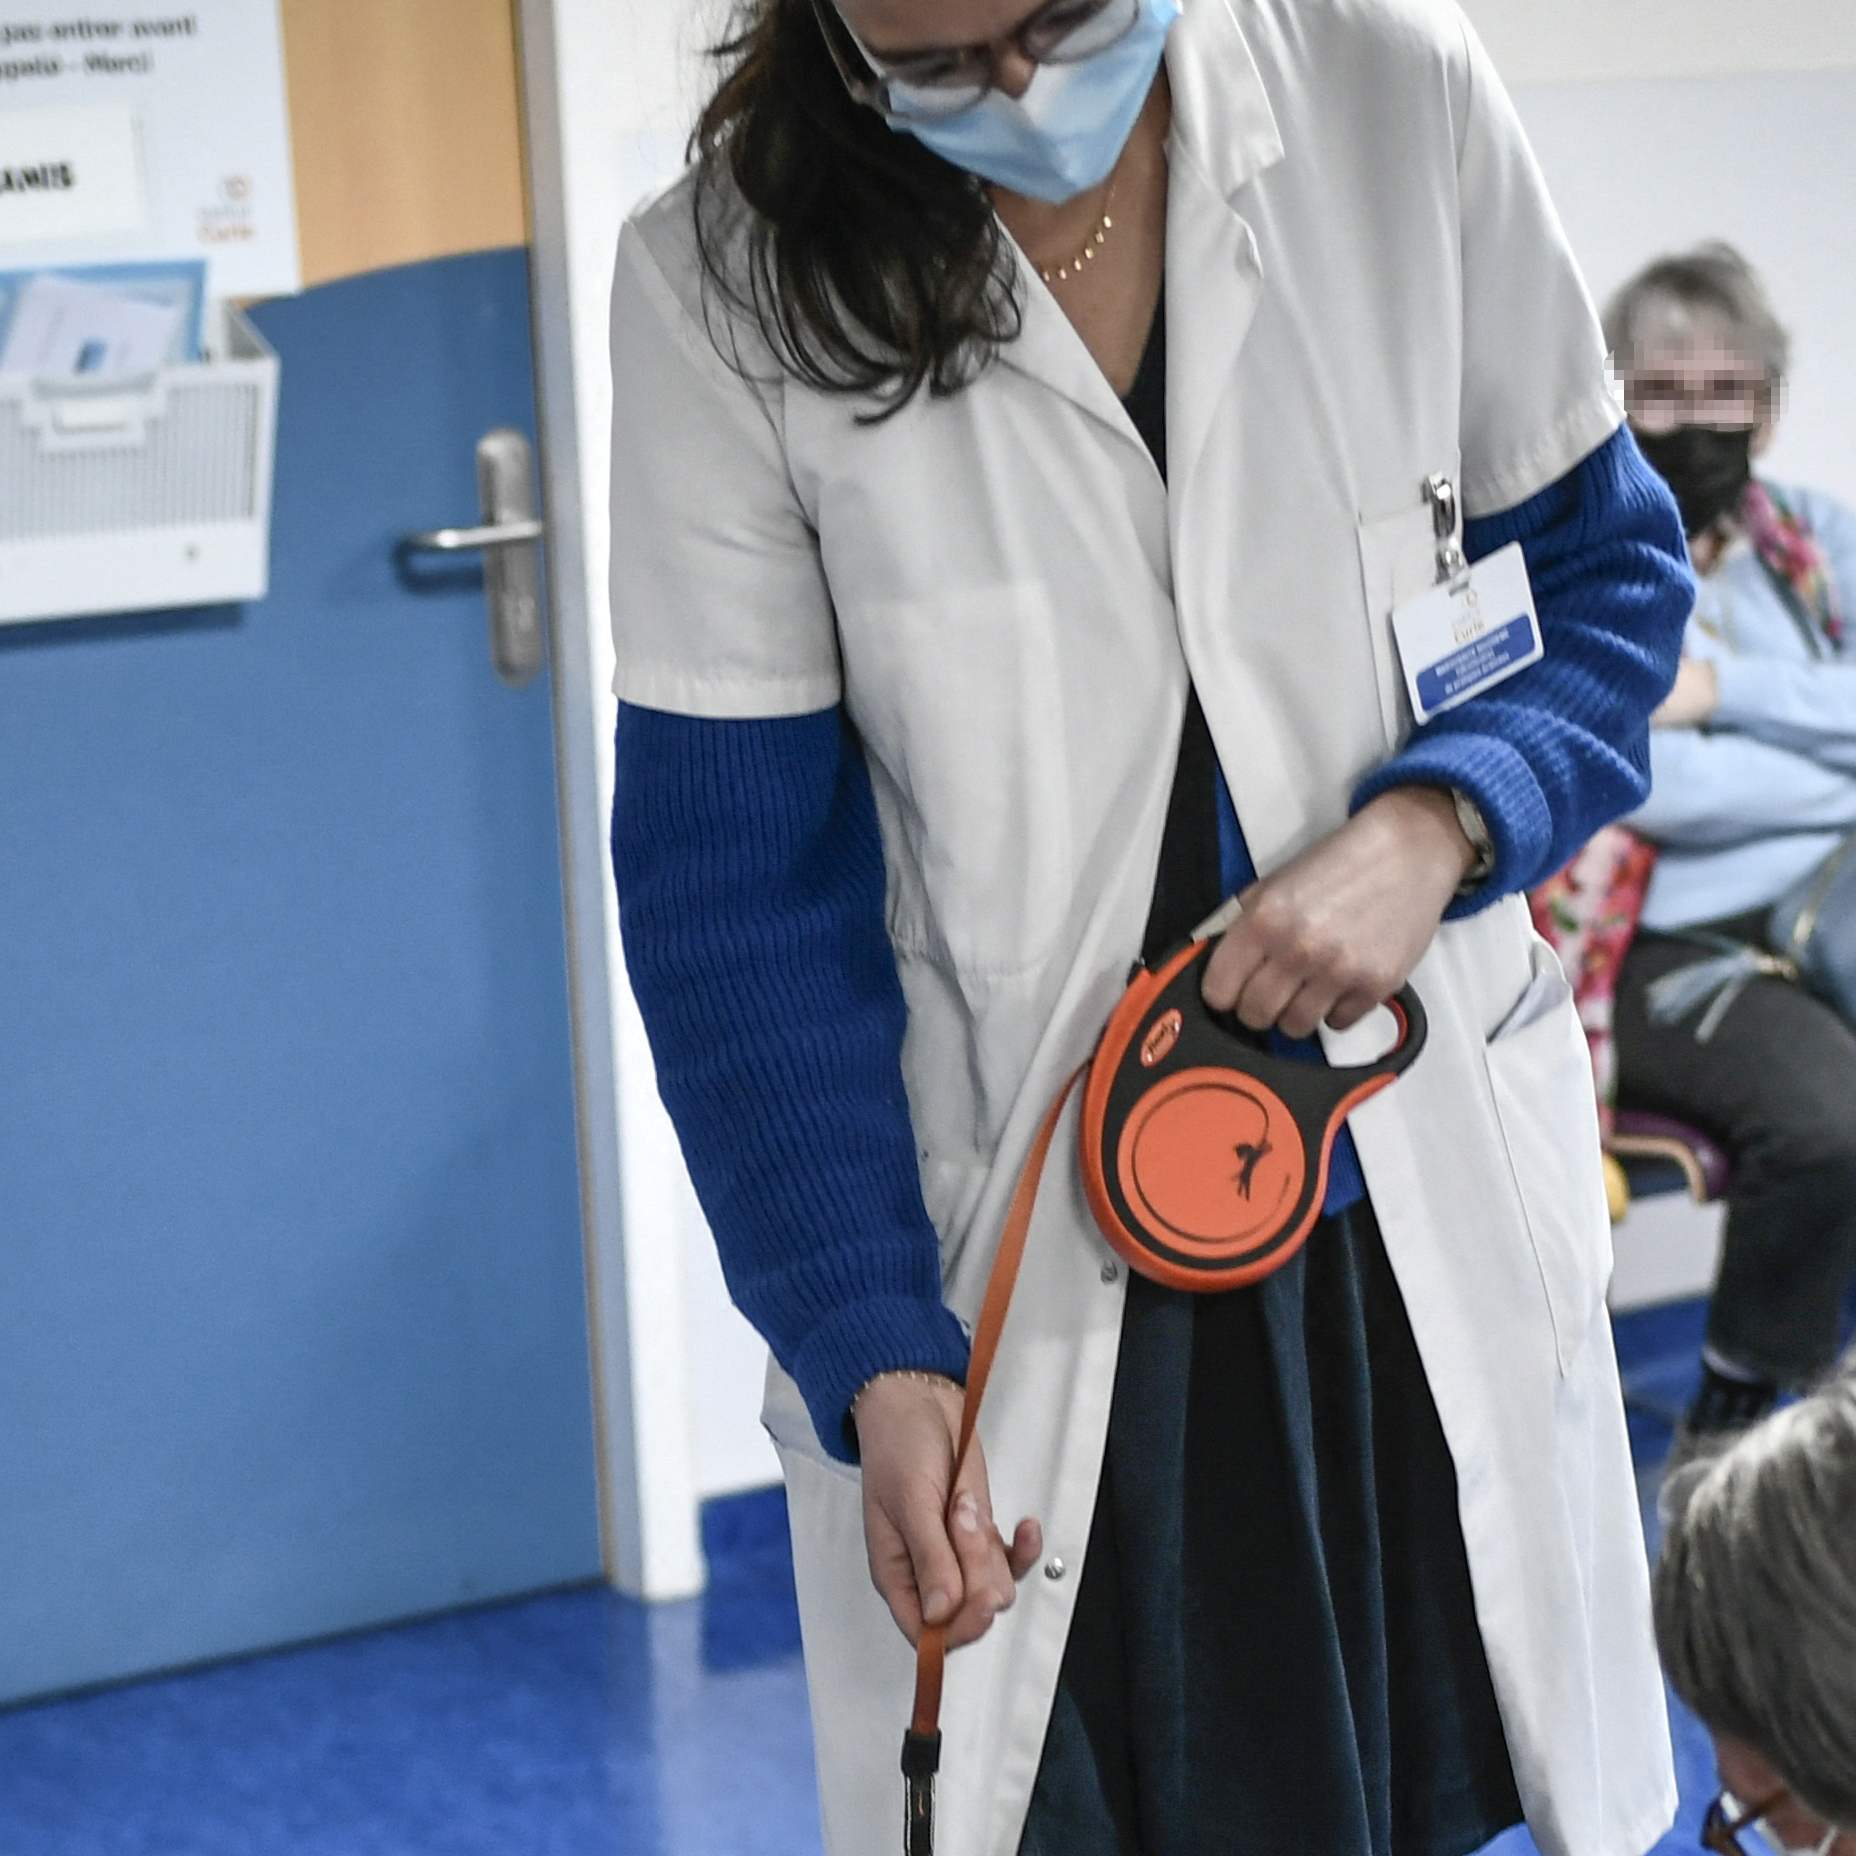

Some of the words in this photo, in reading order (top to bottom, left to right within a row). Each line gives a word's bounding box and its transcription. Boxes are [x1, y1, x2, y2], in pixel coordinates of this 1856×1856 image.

[46, 18, 123, 42] entrer
[128, 14, 199, 39] avant
[82, 50, 154, 76] Merci
